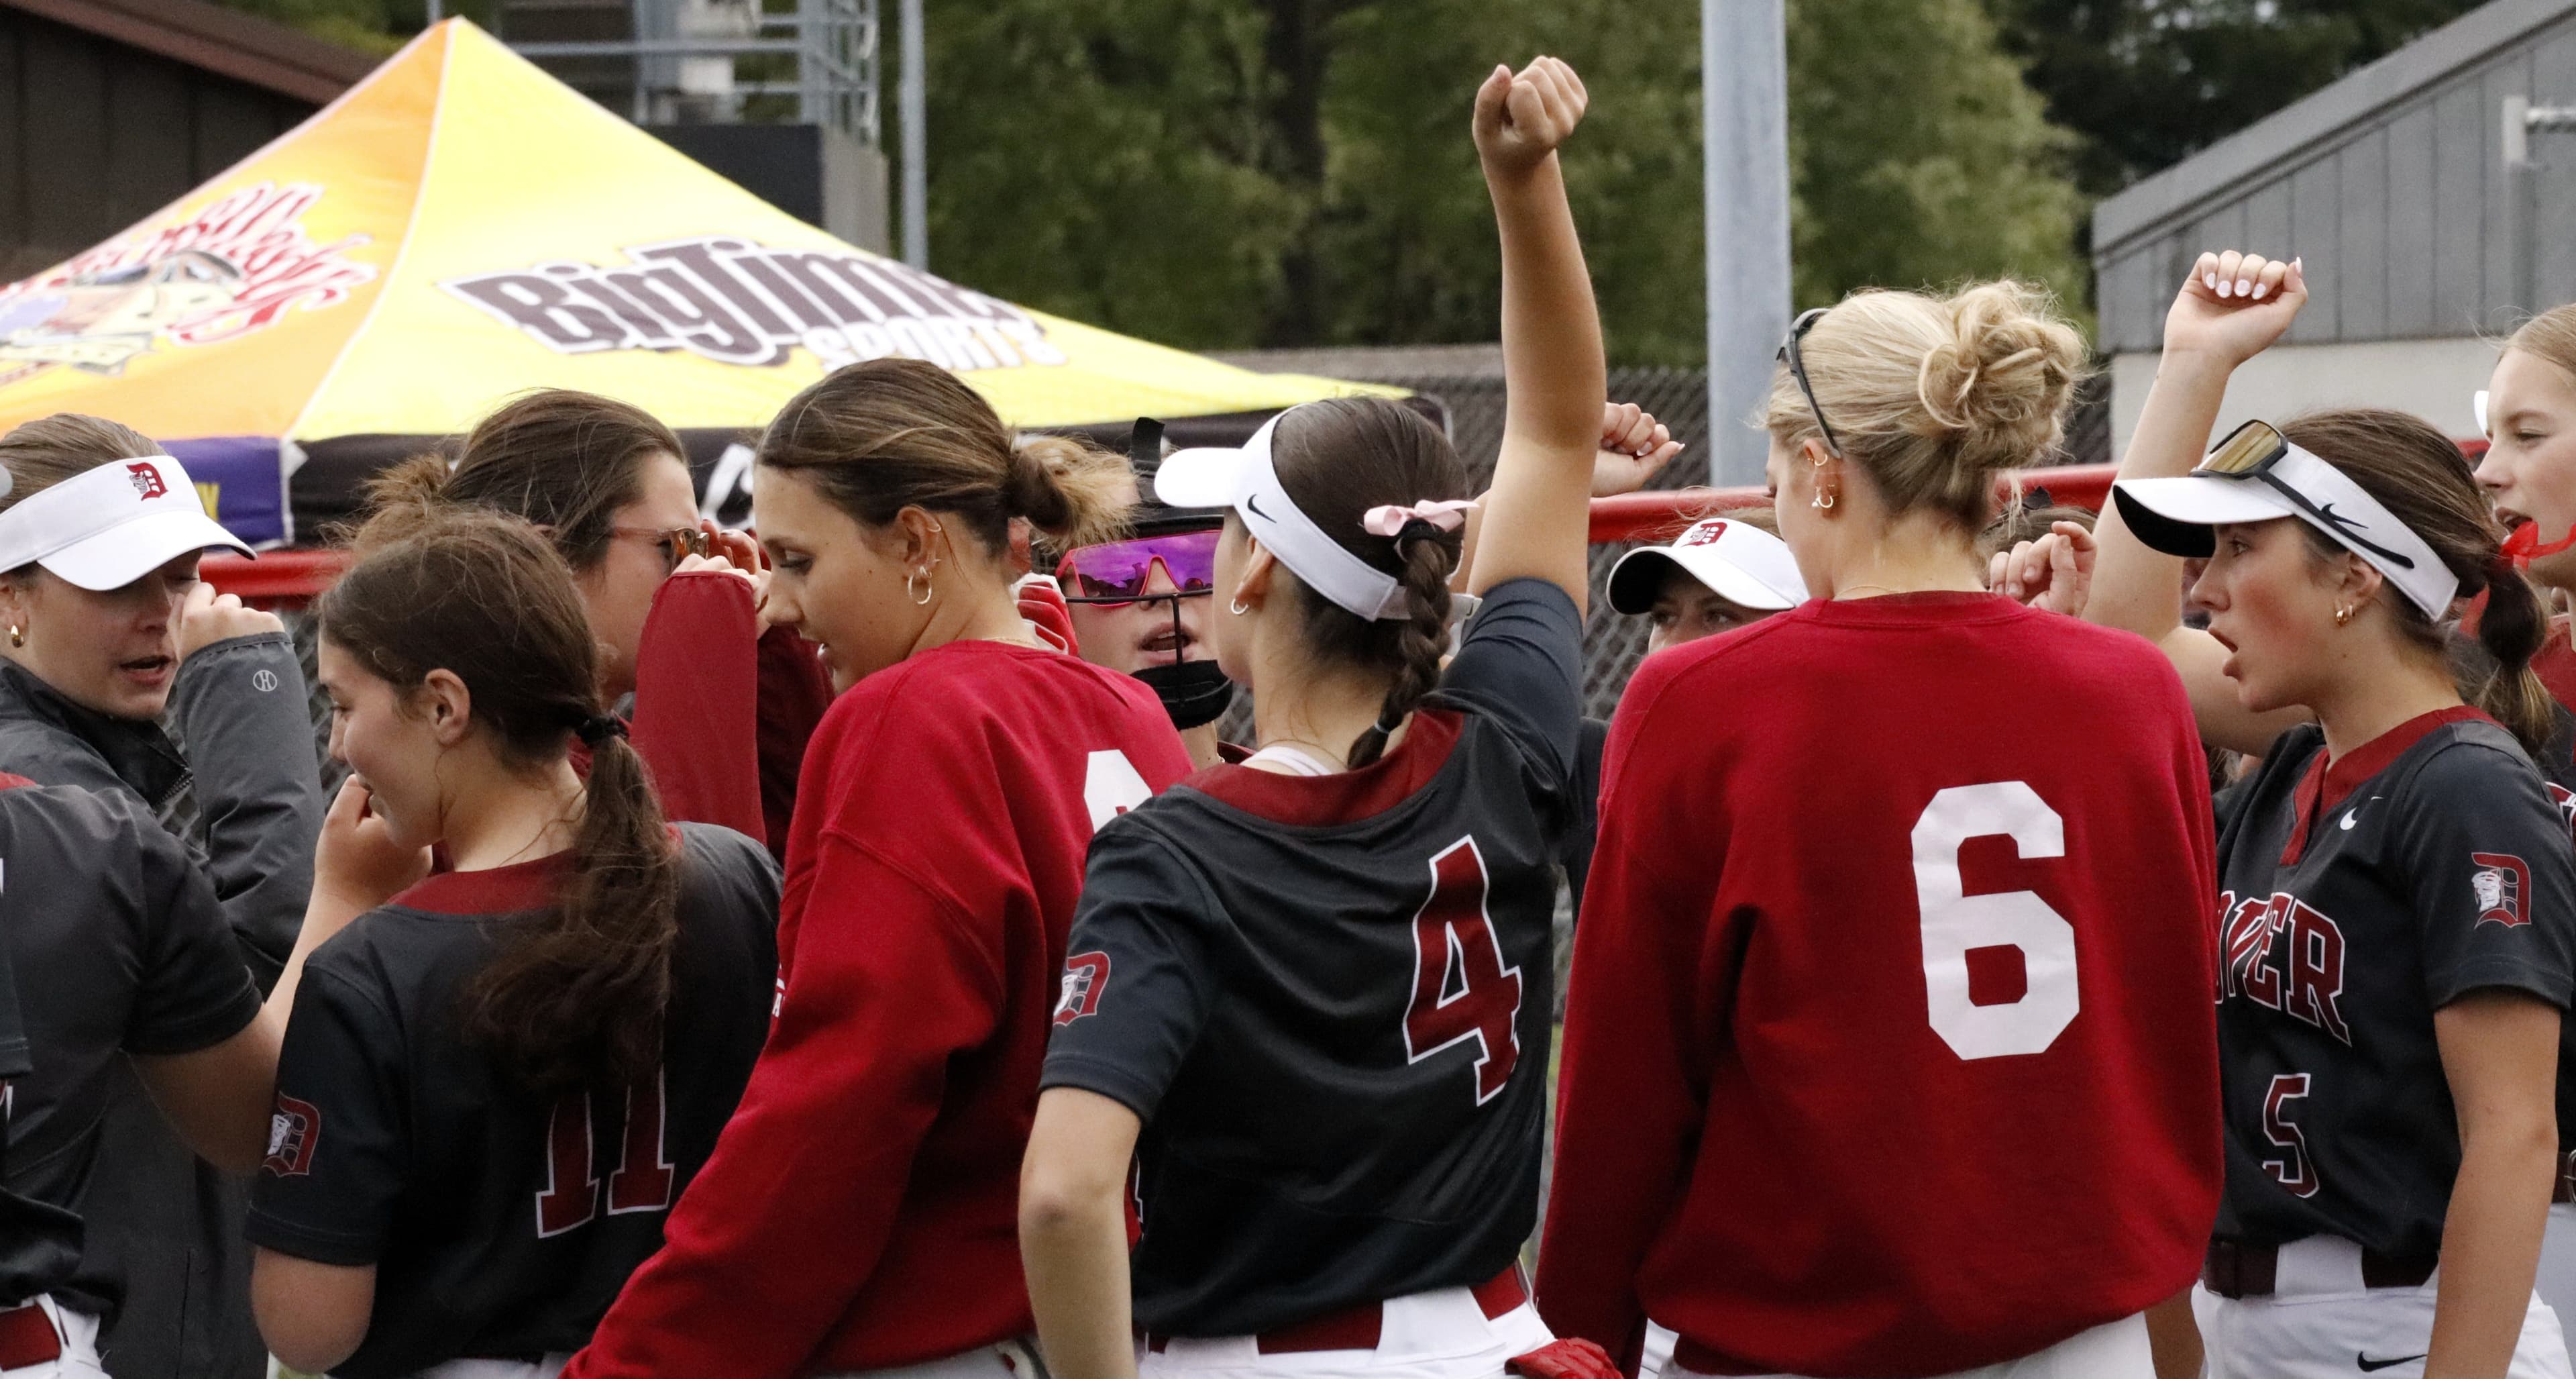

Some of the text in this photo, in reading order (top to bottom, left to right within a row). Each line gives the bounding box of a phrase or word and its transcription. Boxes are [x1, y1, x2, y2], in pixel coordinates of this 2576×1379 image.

[802, 315, 1069, 372] SPORTS
[125, 462, 168, 501] D
[1911, 780, 2080, 1060] 6
[2471, 852, 2532, 930] D
[1403, 834, 1521, 1107] 4
[2262, 1073, 2320, 1198] 5
